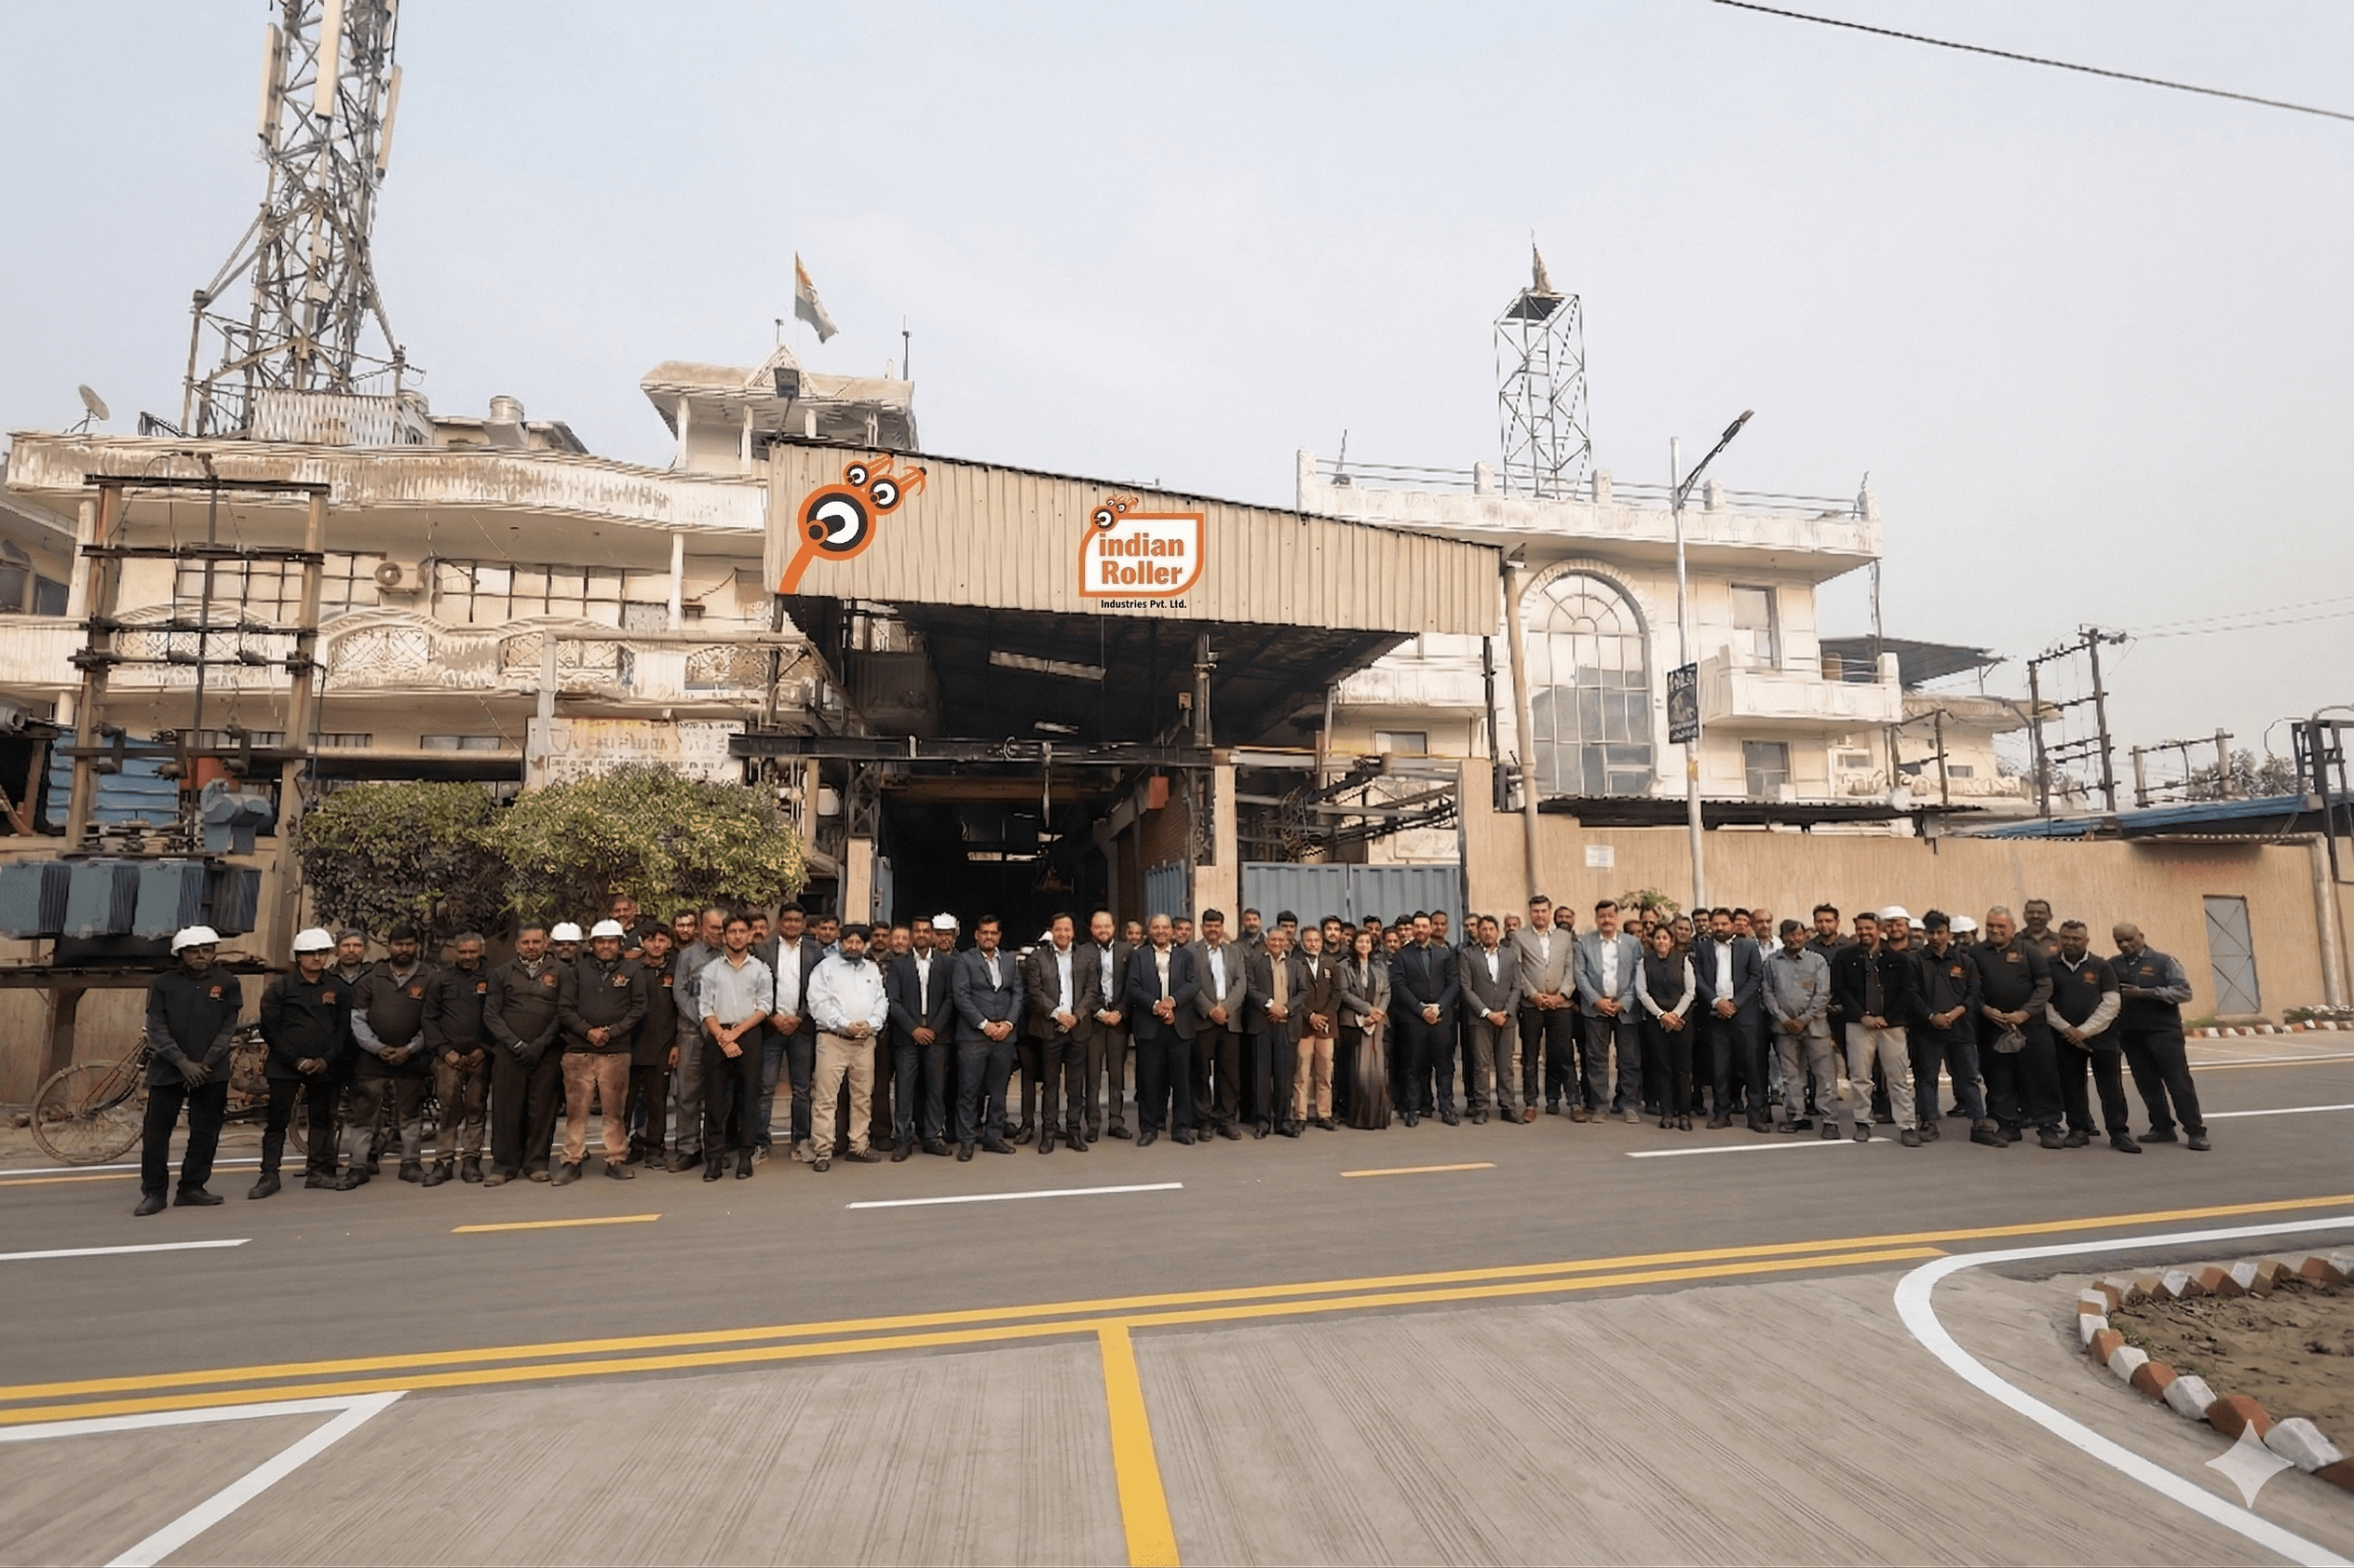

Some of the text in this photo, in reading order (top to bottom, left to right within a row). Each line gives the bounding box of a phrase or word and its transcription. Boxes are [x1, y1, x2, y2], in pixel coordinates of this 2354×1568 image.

[1099, 533, 1184, 557] indian
[1102, 561, 1183, 585] Roller
[1101, 600, 1187, 608] Industries Pvt. Ltd.
